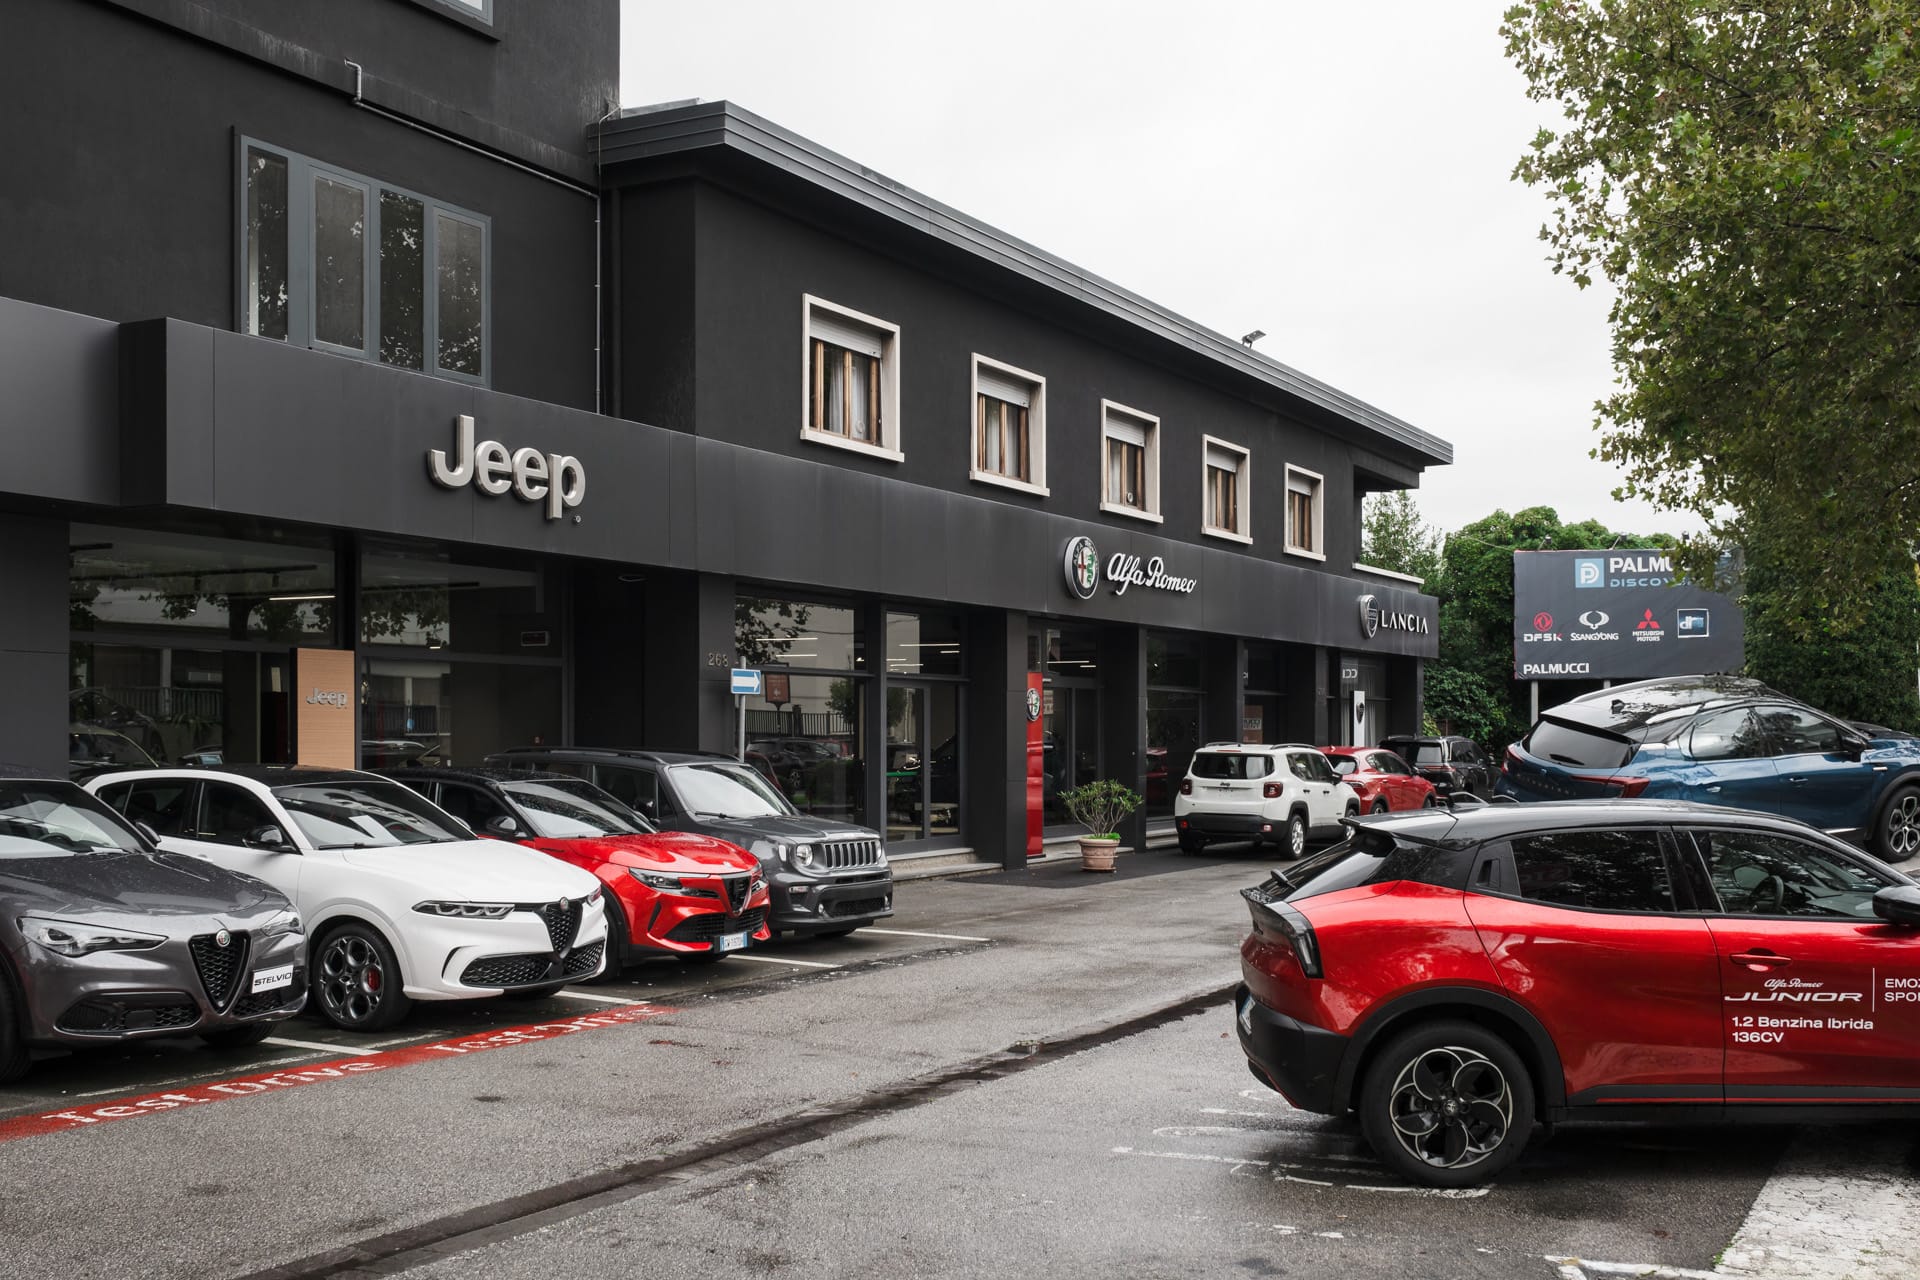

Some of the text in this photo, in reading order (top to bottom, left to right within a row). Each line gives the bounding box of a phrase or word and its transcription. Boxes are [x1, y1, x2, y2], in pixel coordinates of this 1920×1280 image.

[429, 414, 586, 519] Jeep
[1107, 553, 1146, 595] Alfa
[1146, 556, 1197, 593] Romeo
[1381, 610, 1429, 634] LANCIA
[1523, 633, 1563, 642] DFSK
[1523, 662, 1590, 674] PALMUCCI
[306, 687, 348, 709] Jeep
[254, 972, 292, 987] STELVIO
[1764, 977, 1824, 991] Alfa Romeo
[1884, 978, 1920, 989] EMO
[1724, 992, 1863, 1002] JUNIOR
[1884, 991, 1920, 1002] SPO
[1732, 1016, 1874, 1031] 1.2 Benzina Ibrida
[1732, 1031, 1785, 1043] 136CV
[41, 1062, 387, 1126] Test Drive
